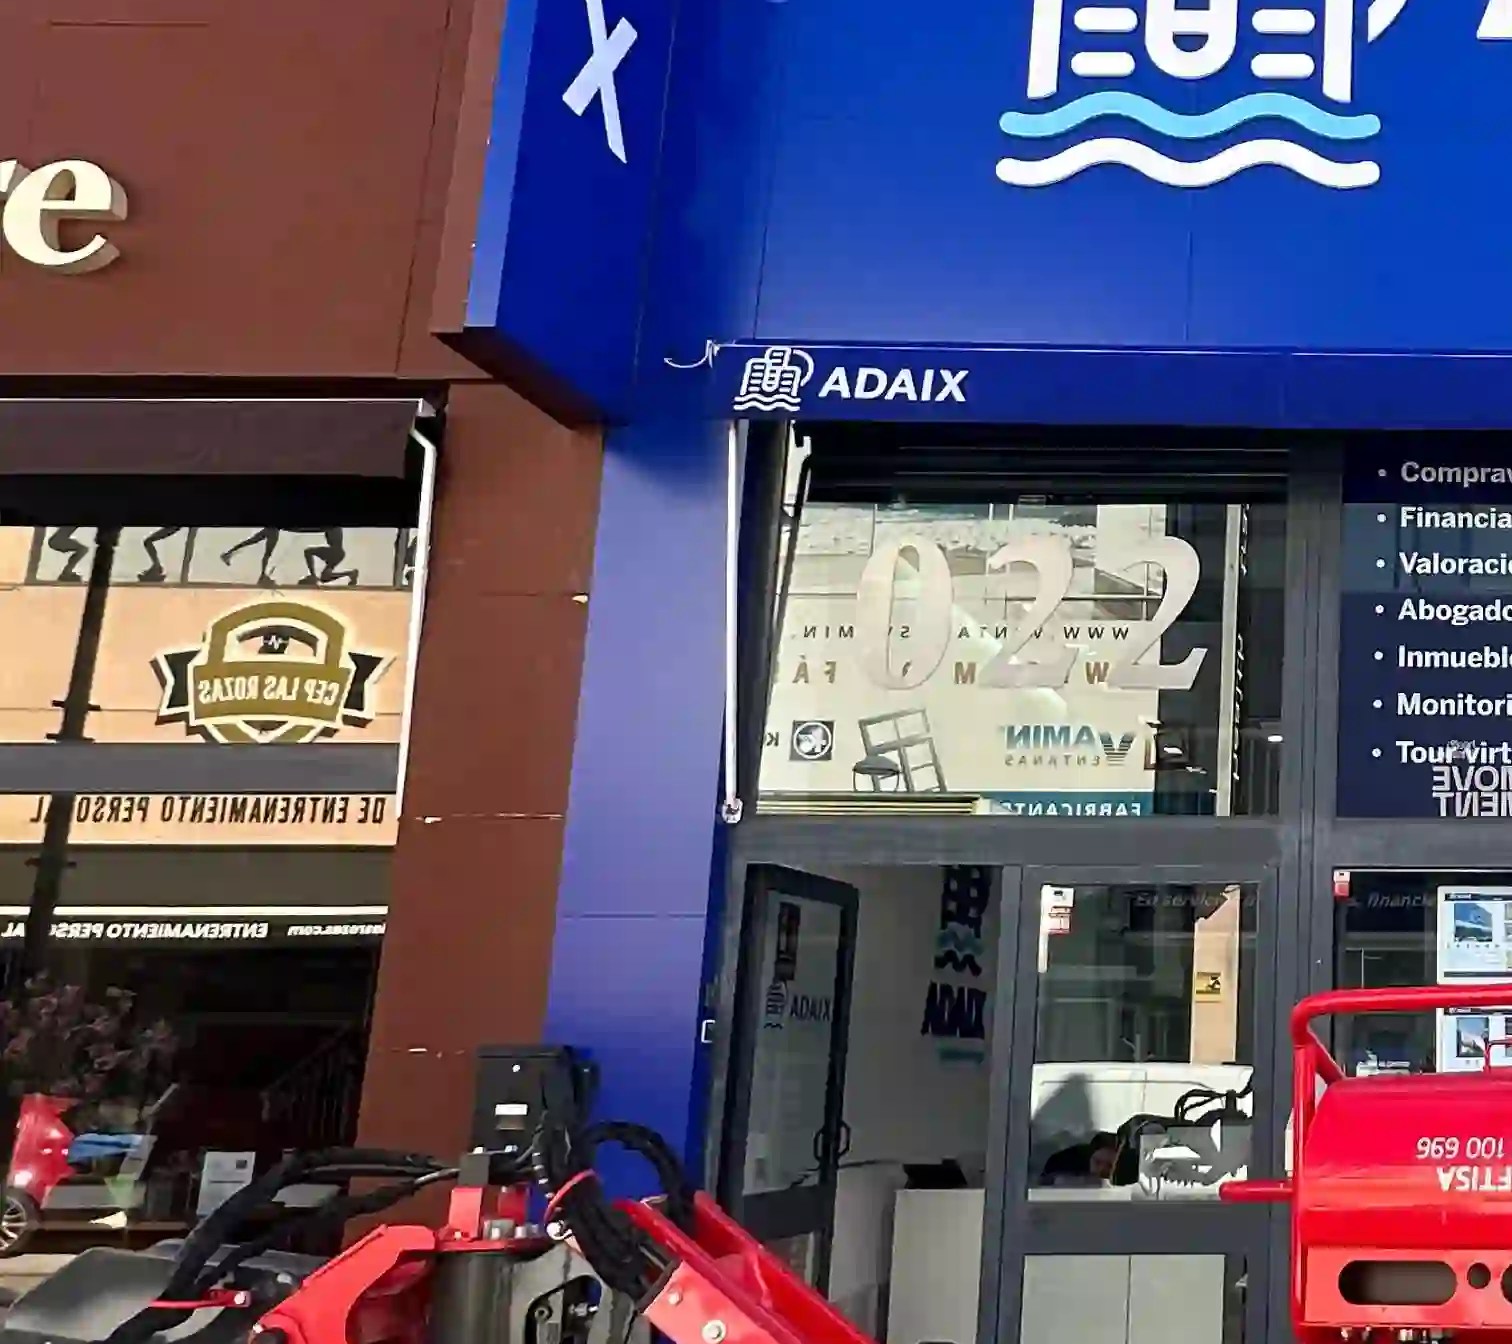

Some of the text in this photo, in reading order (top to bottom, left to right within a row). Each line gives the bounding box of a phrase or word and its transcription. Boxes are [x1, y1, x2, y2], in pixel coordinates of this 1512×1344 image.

[818, 366, 970, 403] ADAIX
[1396, 741, 1454, 765] Tour
[790, 994, 832, 1022] ADAIX
[1416, 1136, 1461, 1160] 696
[1466, 1136, 1505, 1160] 100
